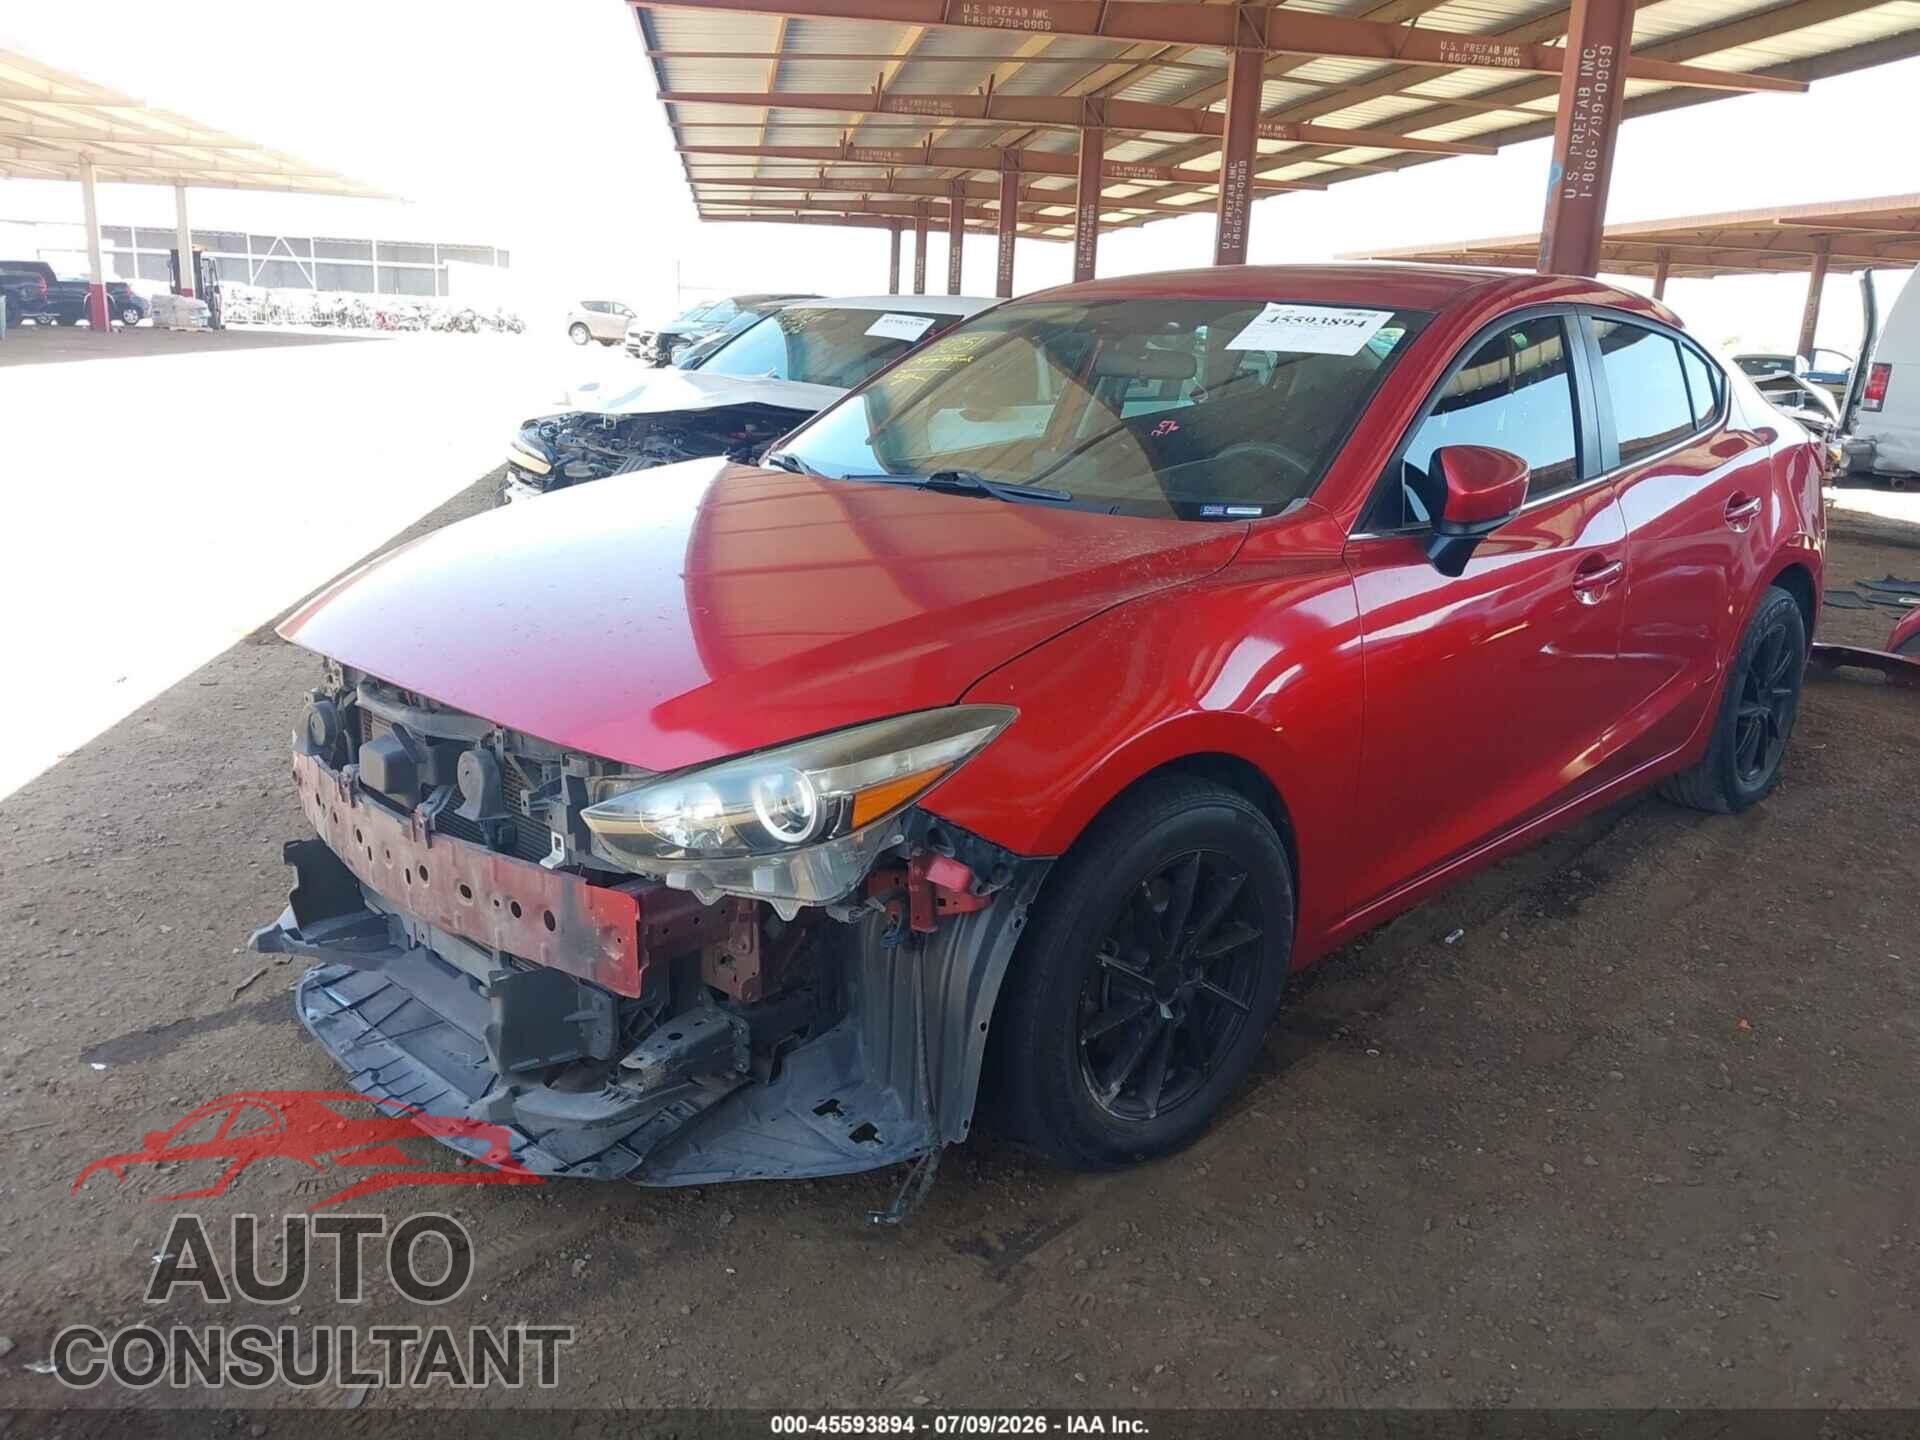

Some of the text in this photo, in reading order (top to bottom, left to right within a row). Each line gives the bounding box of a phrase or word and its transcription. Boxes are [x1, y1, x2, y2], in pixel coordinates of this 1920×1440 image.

[988, 5, 1028, 18] PREFAB
[1440, 40, 1458, 52] U.S.
[1463, 42, 1500, 55] PREFAB
[1440, 51, 1520, 67] 1866-799-0969
[1564, 43, 1598, 199] U.S. PREFAB INC.
[1579, 45, 1613, 198] 1-866-799-0969
